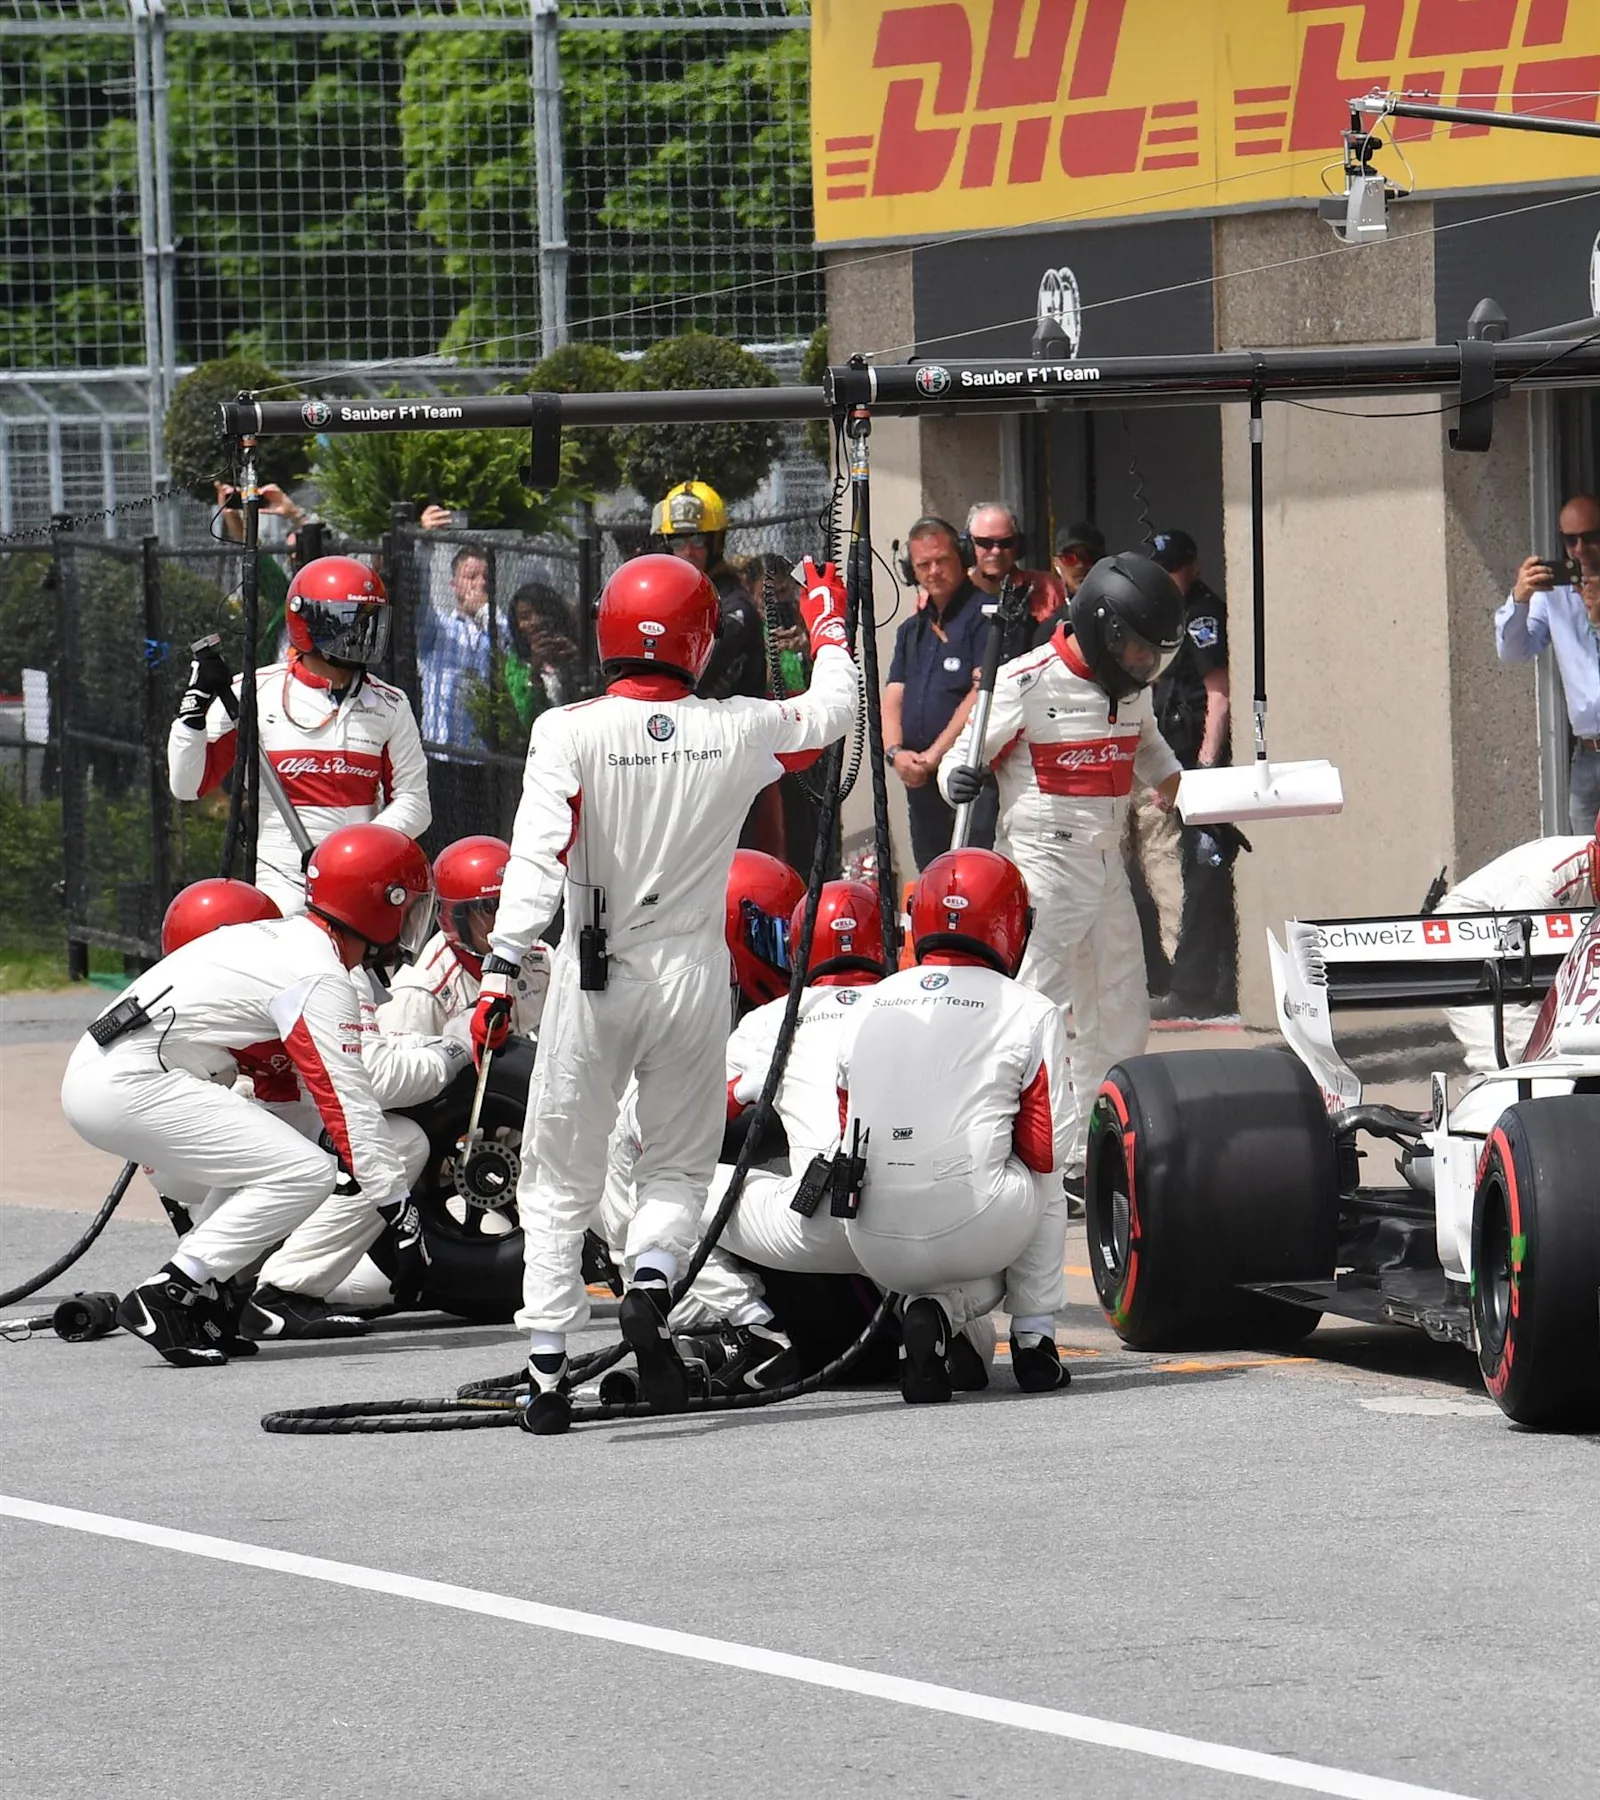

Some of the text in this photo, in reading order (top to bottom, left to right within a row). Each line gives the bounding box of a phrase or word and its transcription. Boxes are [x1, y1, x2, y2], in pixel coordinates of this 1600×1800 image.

[871, 0, 1146, 197] DHL
[961, 370, 1023, 387] Sauber
[1051, 366, 1100, 382] Team
[341, 407, 396, 421] Sauber
[422, 405, 462, 419] Team
[641, 623, 662, 633] BELL
[608, 753, 657, 766] Sauber
[683, 748, 723, 762] Team
[276, 756, 381, 780] Alfa Romeo
[945, 897, 966, 907] BELL
[834, 919, 855, 929] BELL
[872, 997, 917, 1008] Sauber
[944, 995, 985, 1009] Team
[795, 1011, 845, 1026] Sauber
[892, 1128, 914, 1139] OMP
